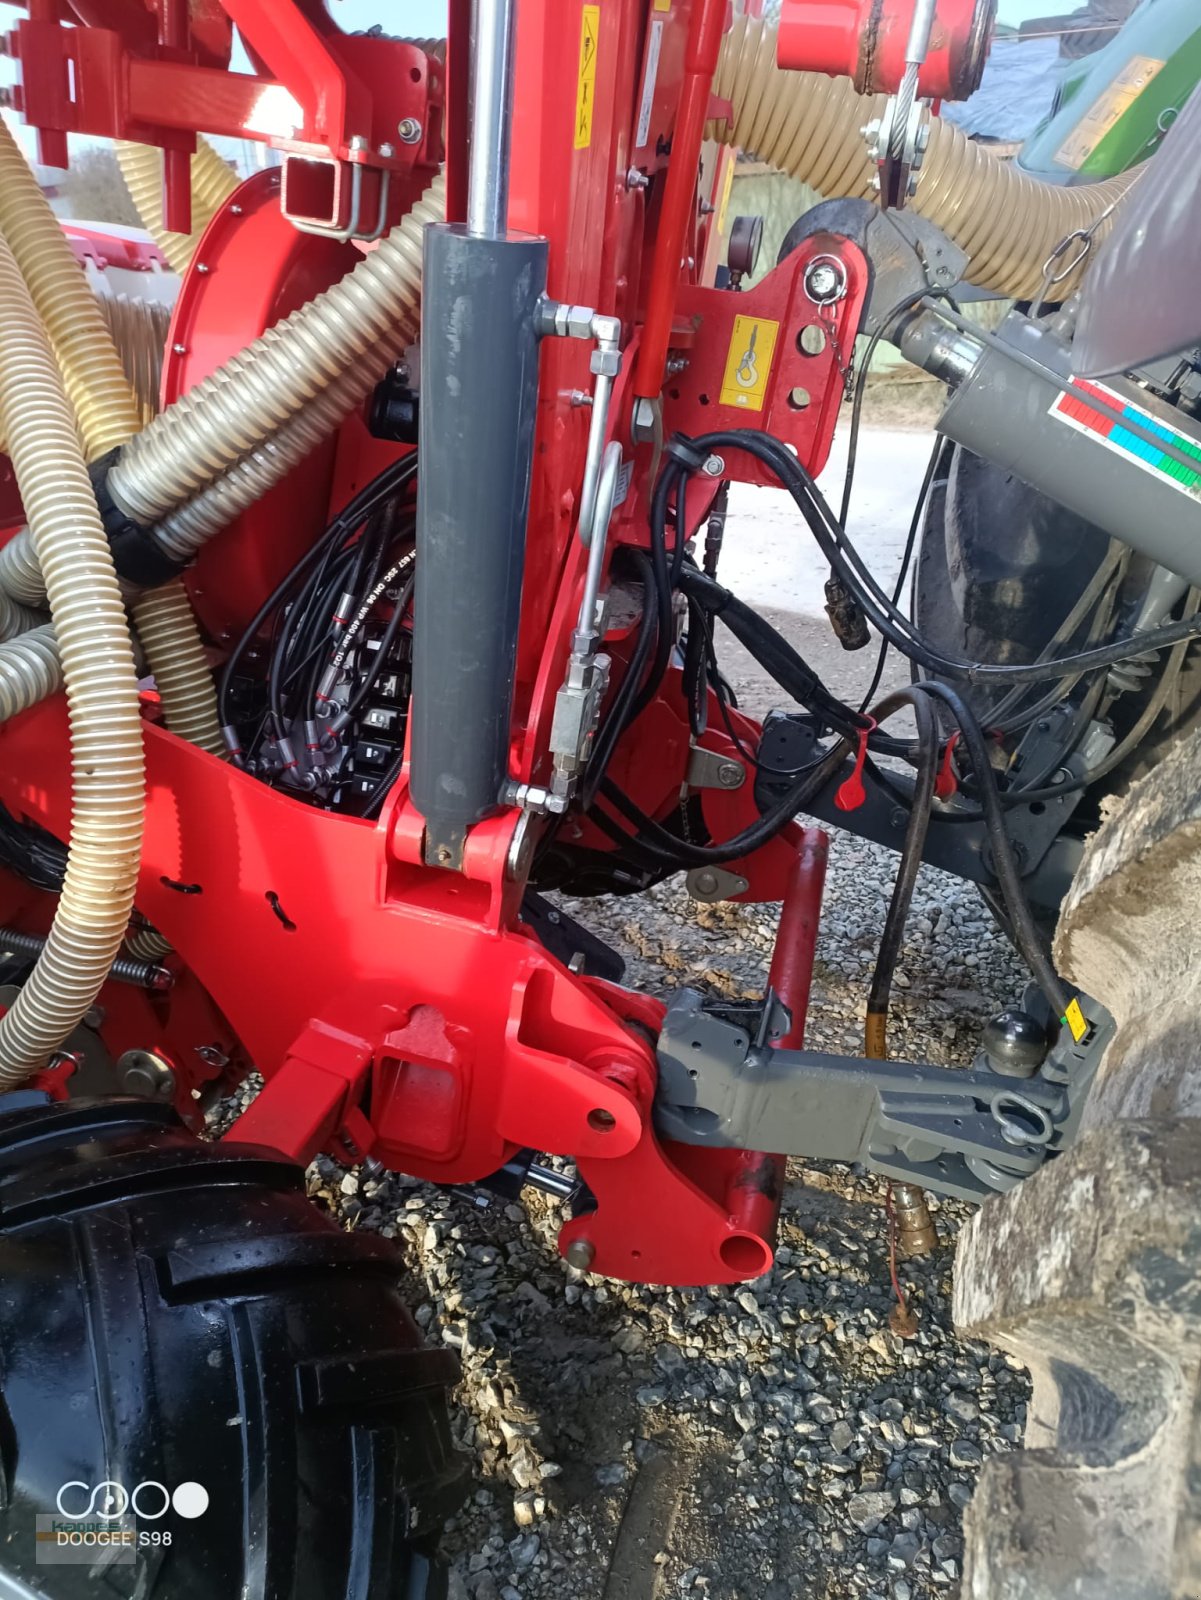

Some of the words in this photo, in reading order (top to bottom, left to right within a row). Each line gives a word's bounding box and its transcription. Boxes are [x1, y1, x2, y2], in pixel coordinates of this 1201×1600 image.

[398, 556, 411, 568] 857
[384, 567, 398, 581] 2SC
[373, 583, 385, 595] DN
[366, 594, 377, 605] 06
[358, 606, 369, 619] WP
[348, 620, 359, 634] 400
[342, 634, 352, 647] bar
